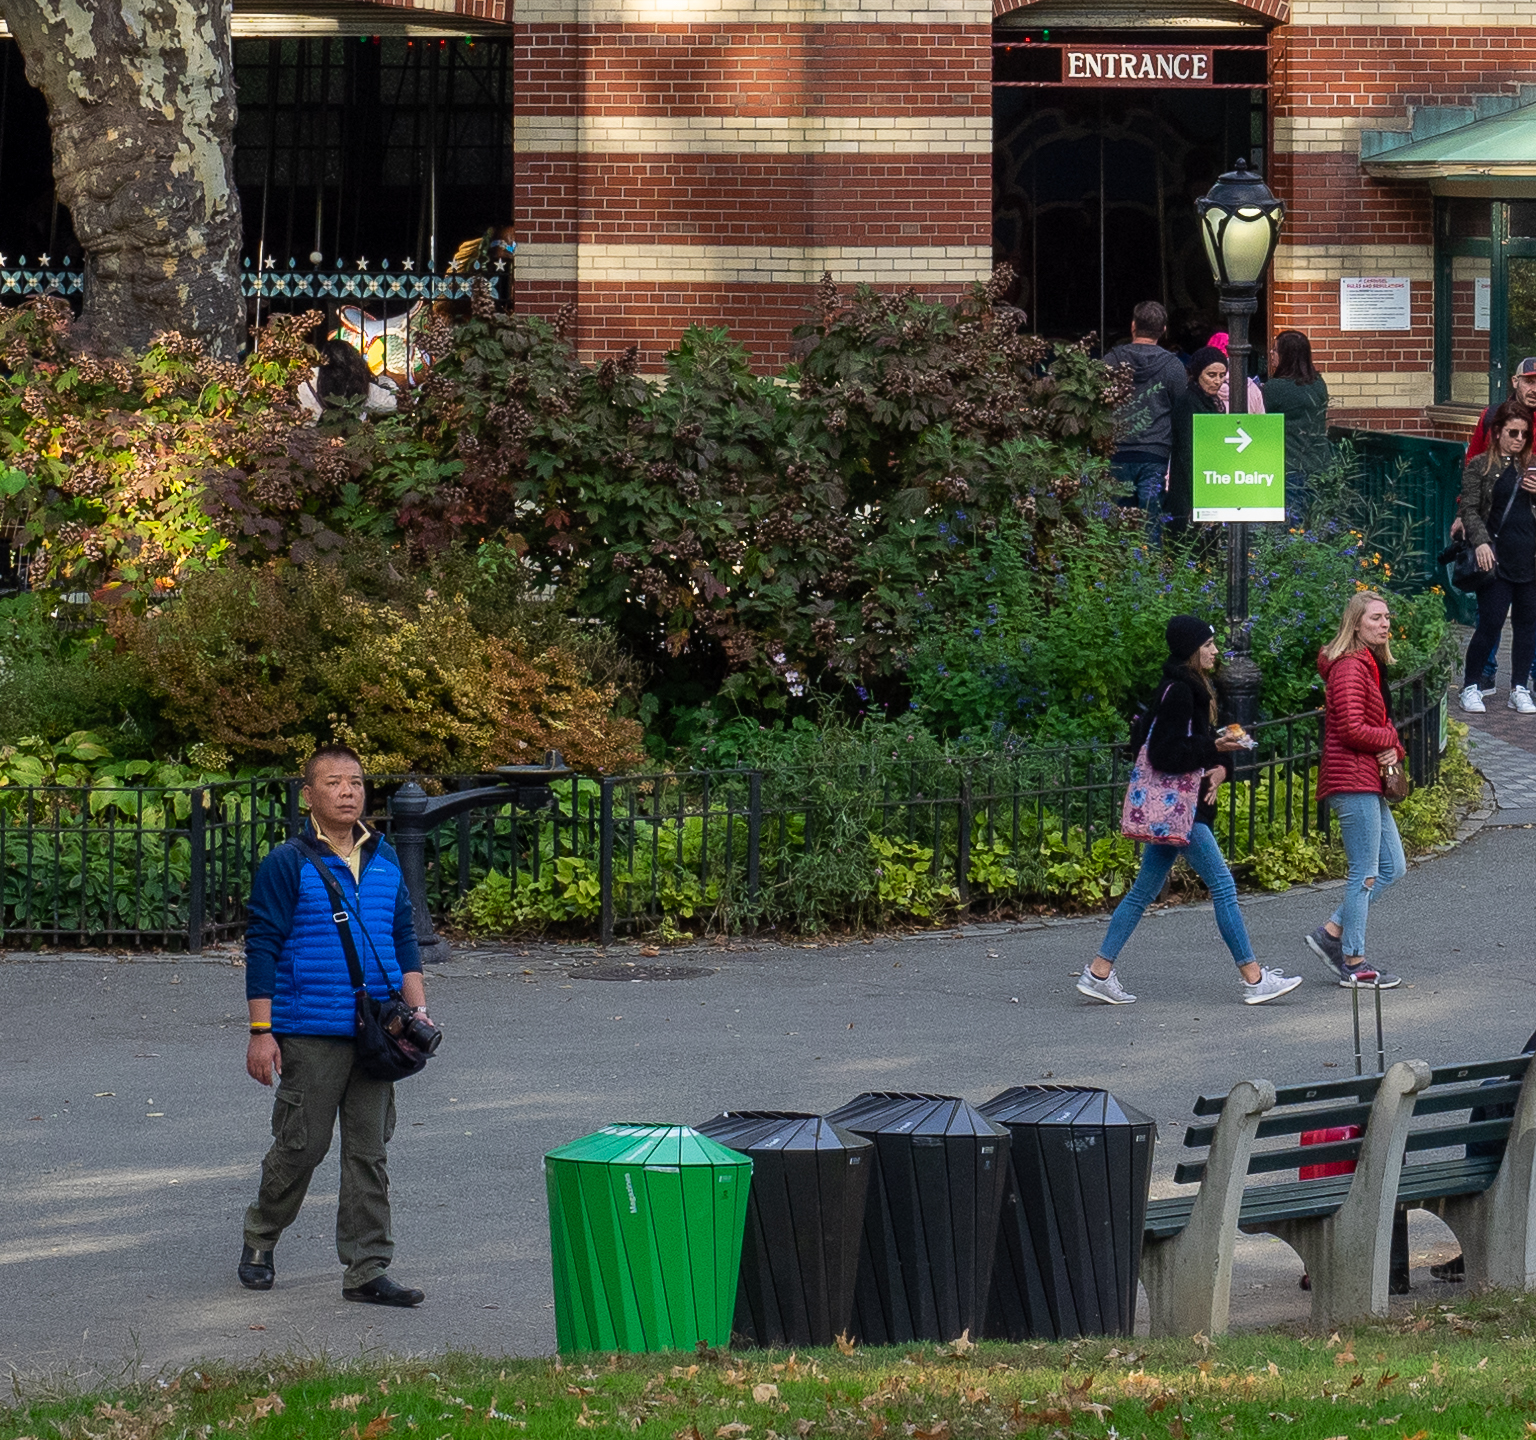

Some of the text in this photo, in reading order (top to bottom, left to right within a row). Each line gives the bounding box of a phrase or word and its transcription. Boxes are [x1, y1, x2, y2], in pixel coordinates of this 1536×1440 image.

[1067, 52, 1208, 80] ENTRANCE
[1203, 470, 1274, 487] The Dairy
